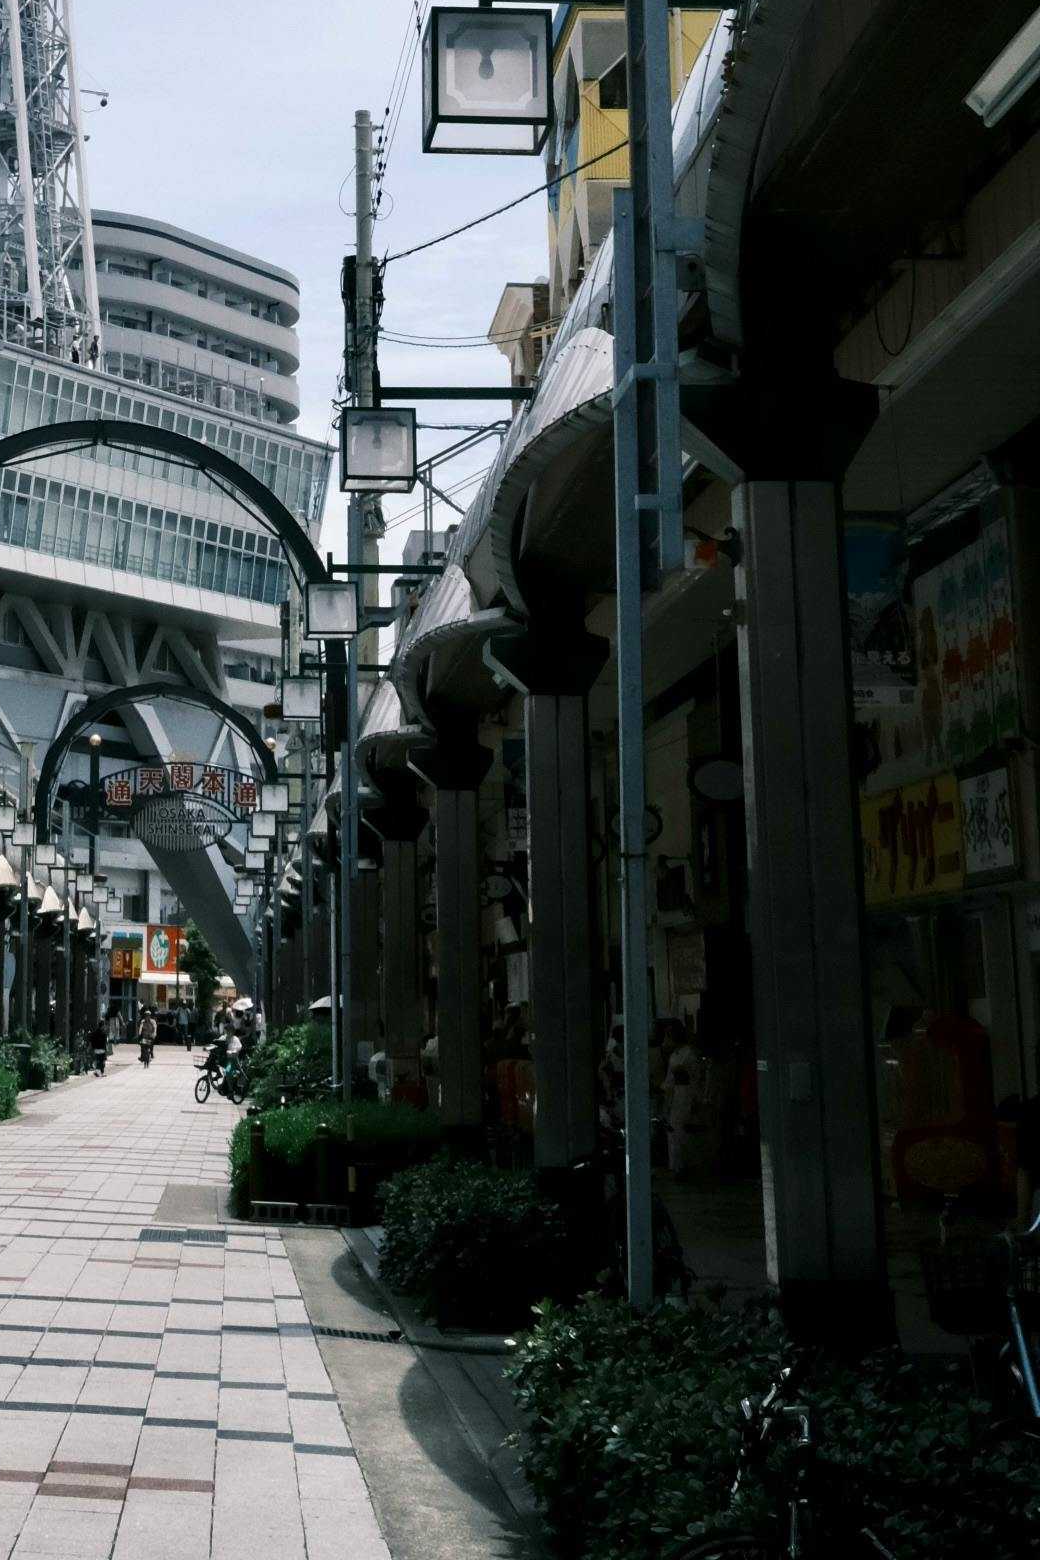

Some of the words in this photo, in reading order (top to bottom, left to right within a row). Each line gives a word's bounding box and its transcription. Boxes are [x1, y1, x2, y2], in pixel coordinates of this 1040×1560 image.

[106, 764, 257, 807] 通天閣本通
[159, 807, 206, 820] OSAKA
[148, 823, 216, 836] SHINSEKAI
